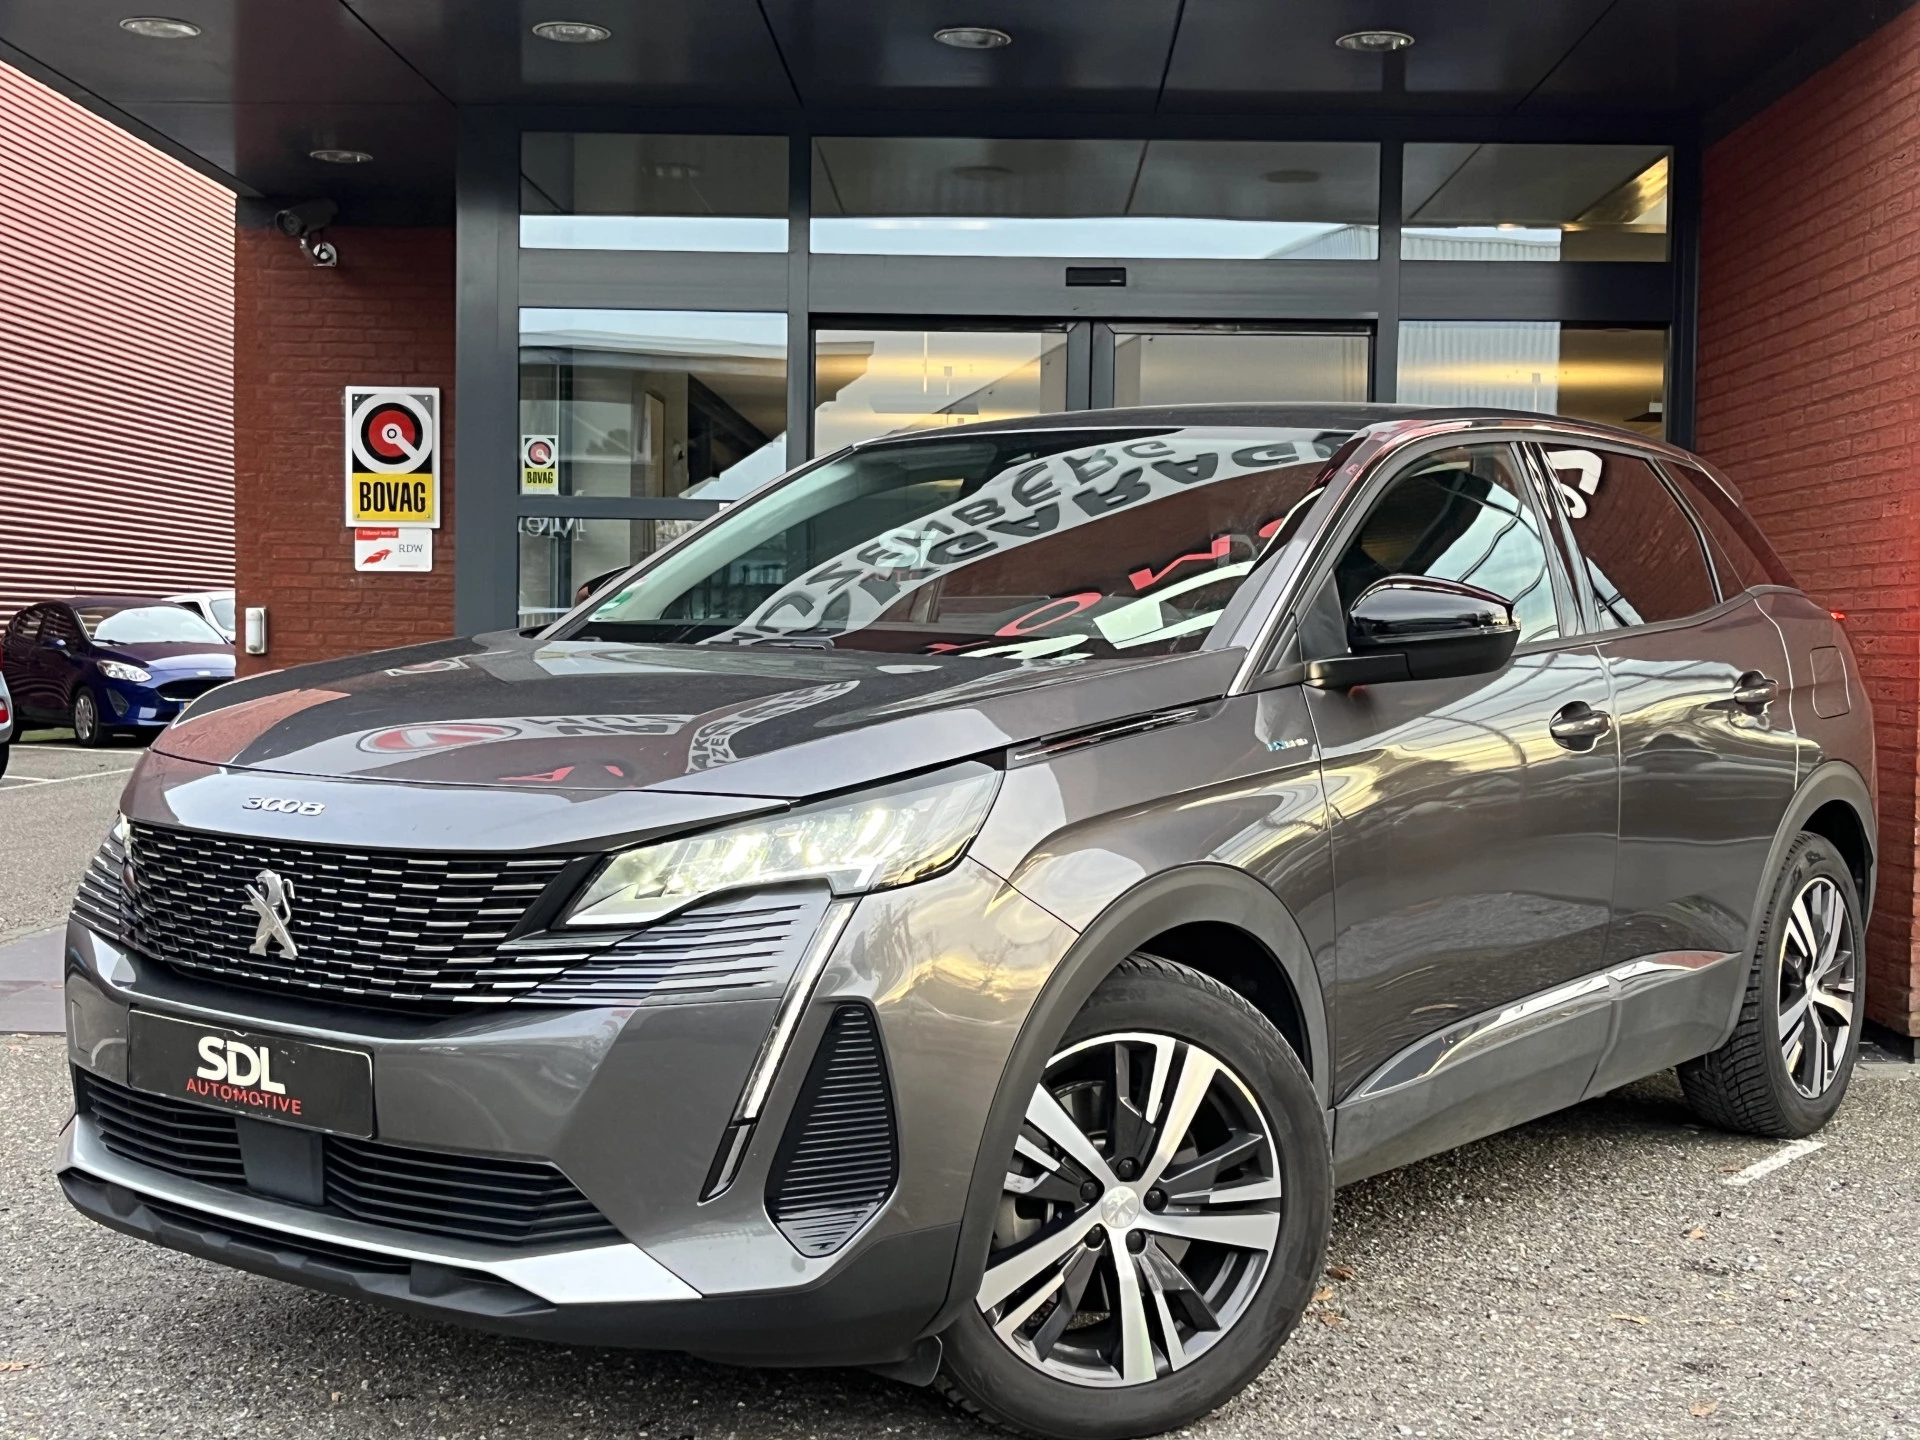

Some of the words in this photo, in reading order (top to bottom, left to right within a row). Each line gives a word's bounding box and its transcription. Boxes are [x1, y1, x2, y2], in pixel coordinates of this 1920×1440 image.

[527, 472, 553, 484] BOVAG
[360, 482, 426, 512] BOVAG
[398, 544, 423, 553] RDW
[242, 797, 326, 816] 3008
[196, 1036, 286, 1095] SDL
[186, 1078, 302, 1115] AUTOMOTIVE
